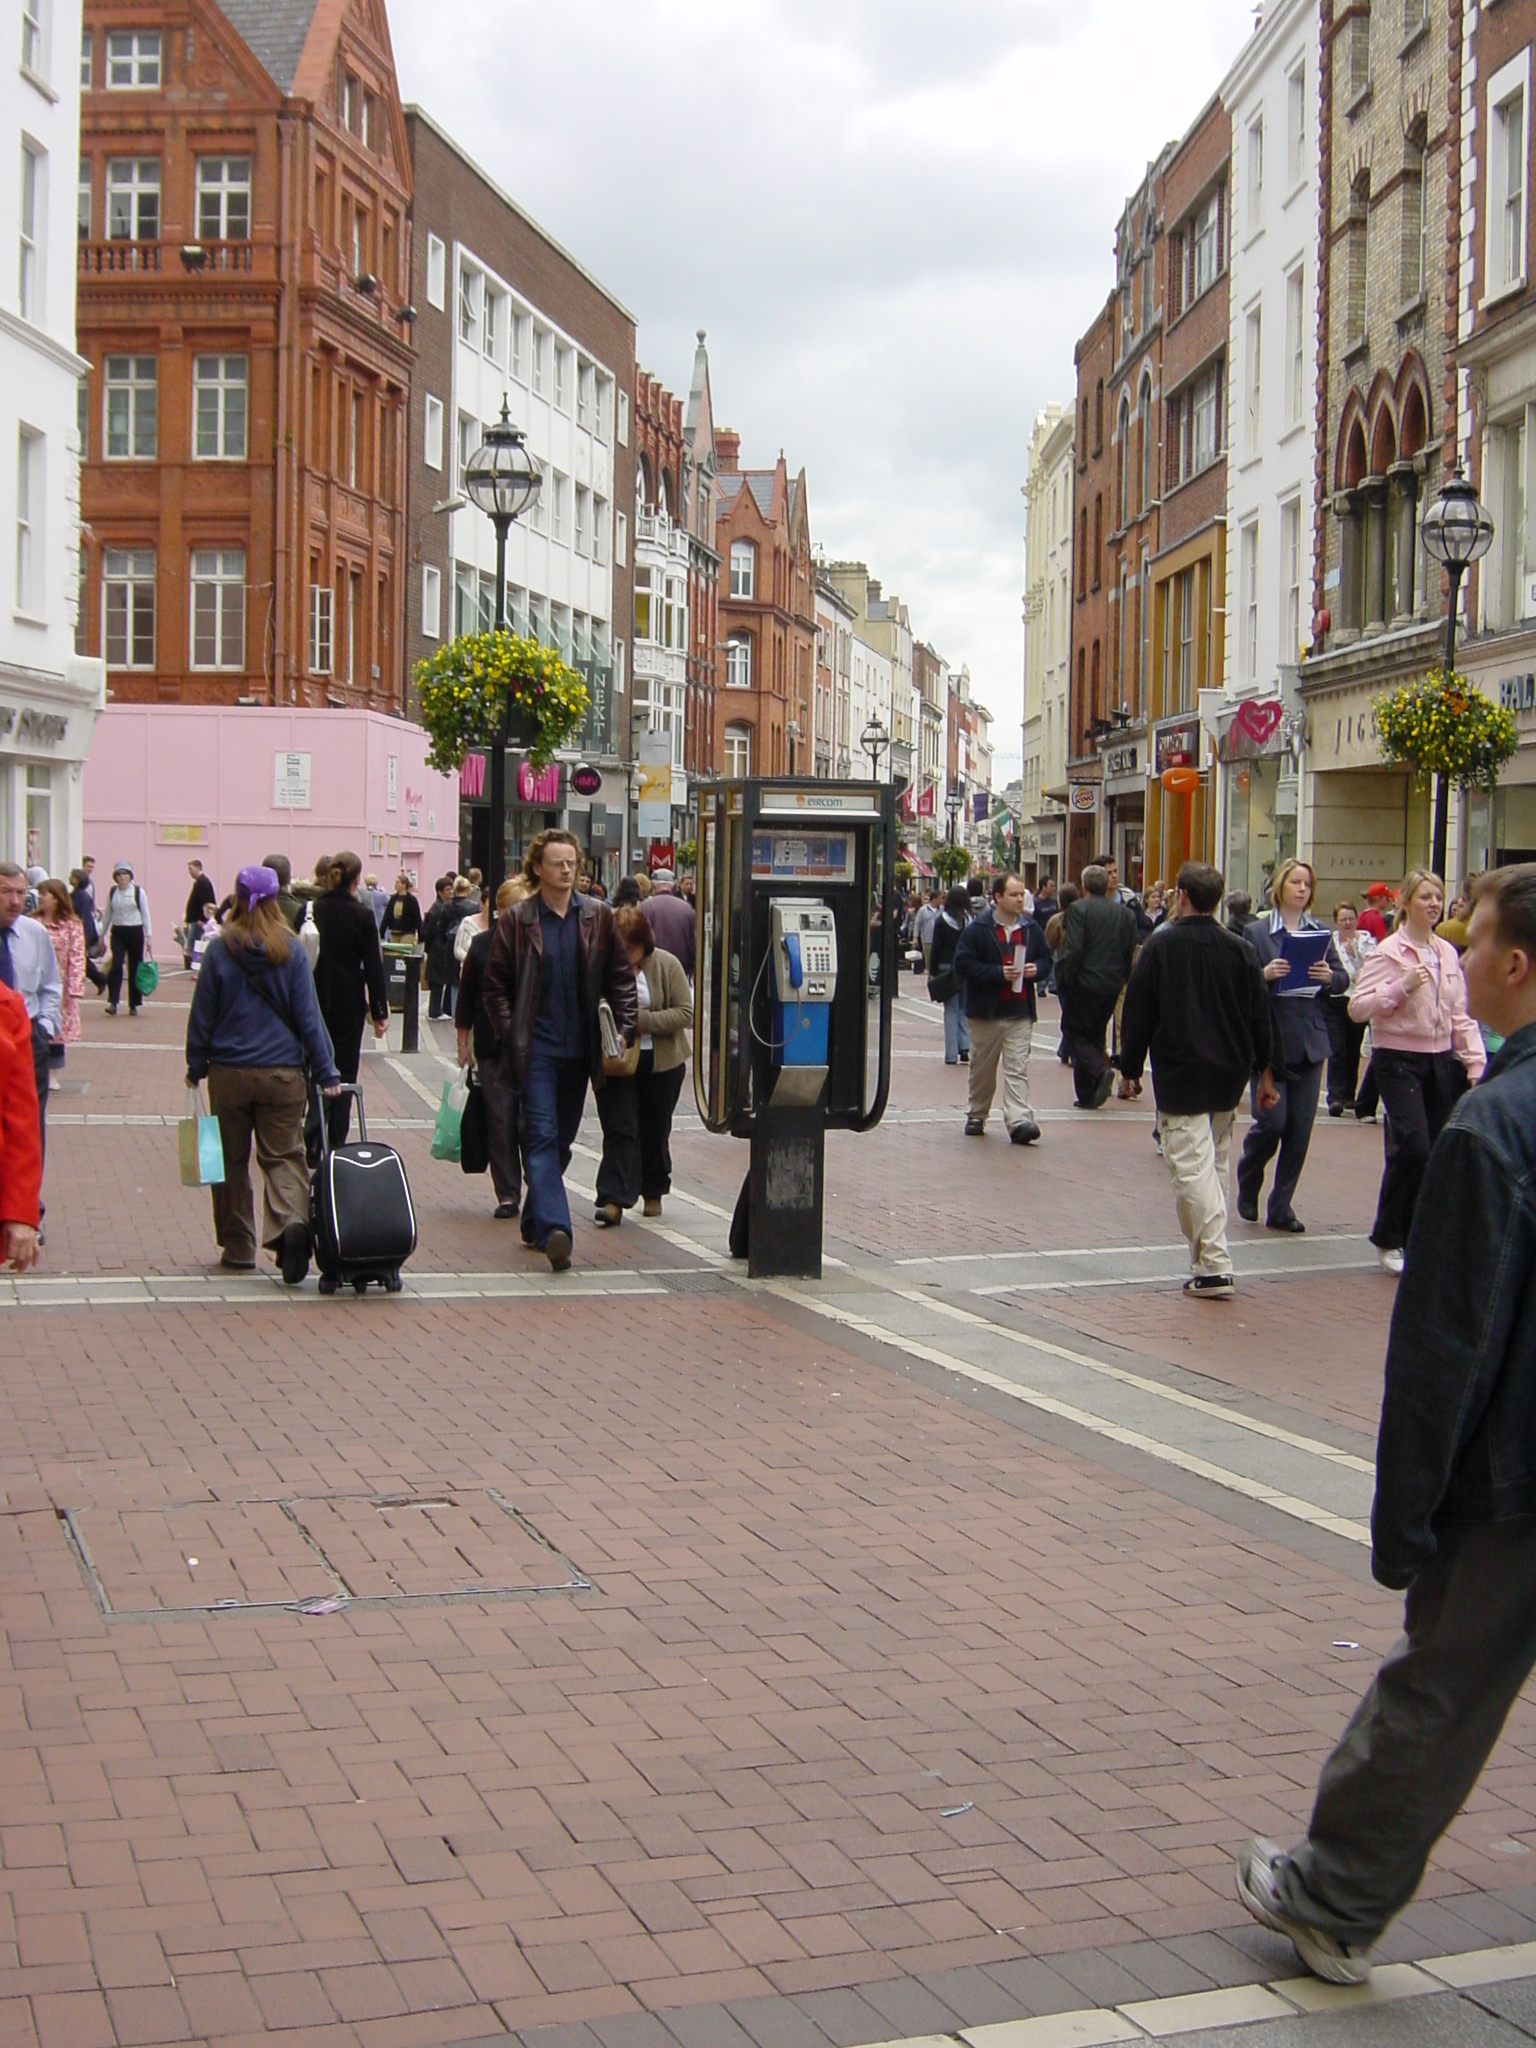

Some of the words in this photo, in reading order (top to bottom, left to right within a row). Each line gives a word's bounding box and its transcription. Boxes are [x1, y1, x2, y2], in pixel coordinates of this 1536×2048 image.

[593, 673, 606, 737] NEXT
[1498, 673, 1536, 710] BAL
[574, 774, 599, 787] HMV
